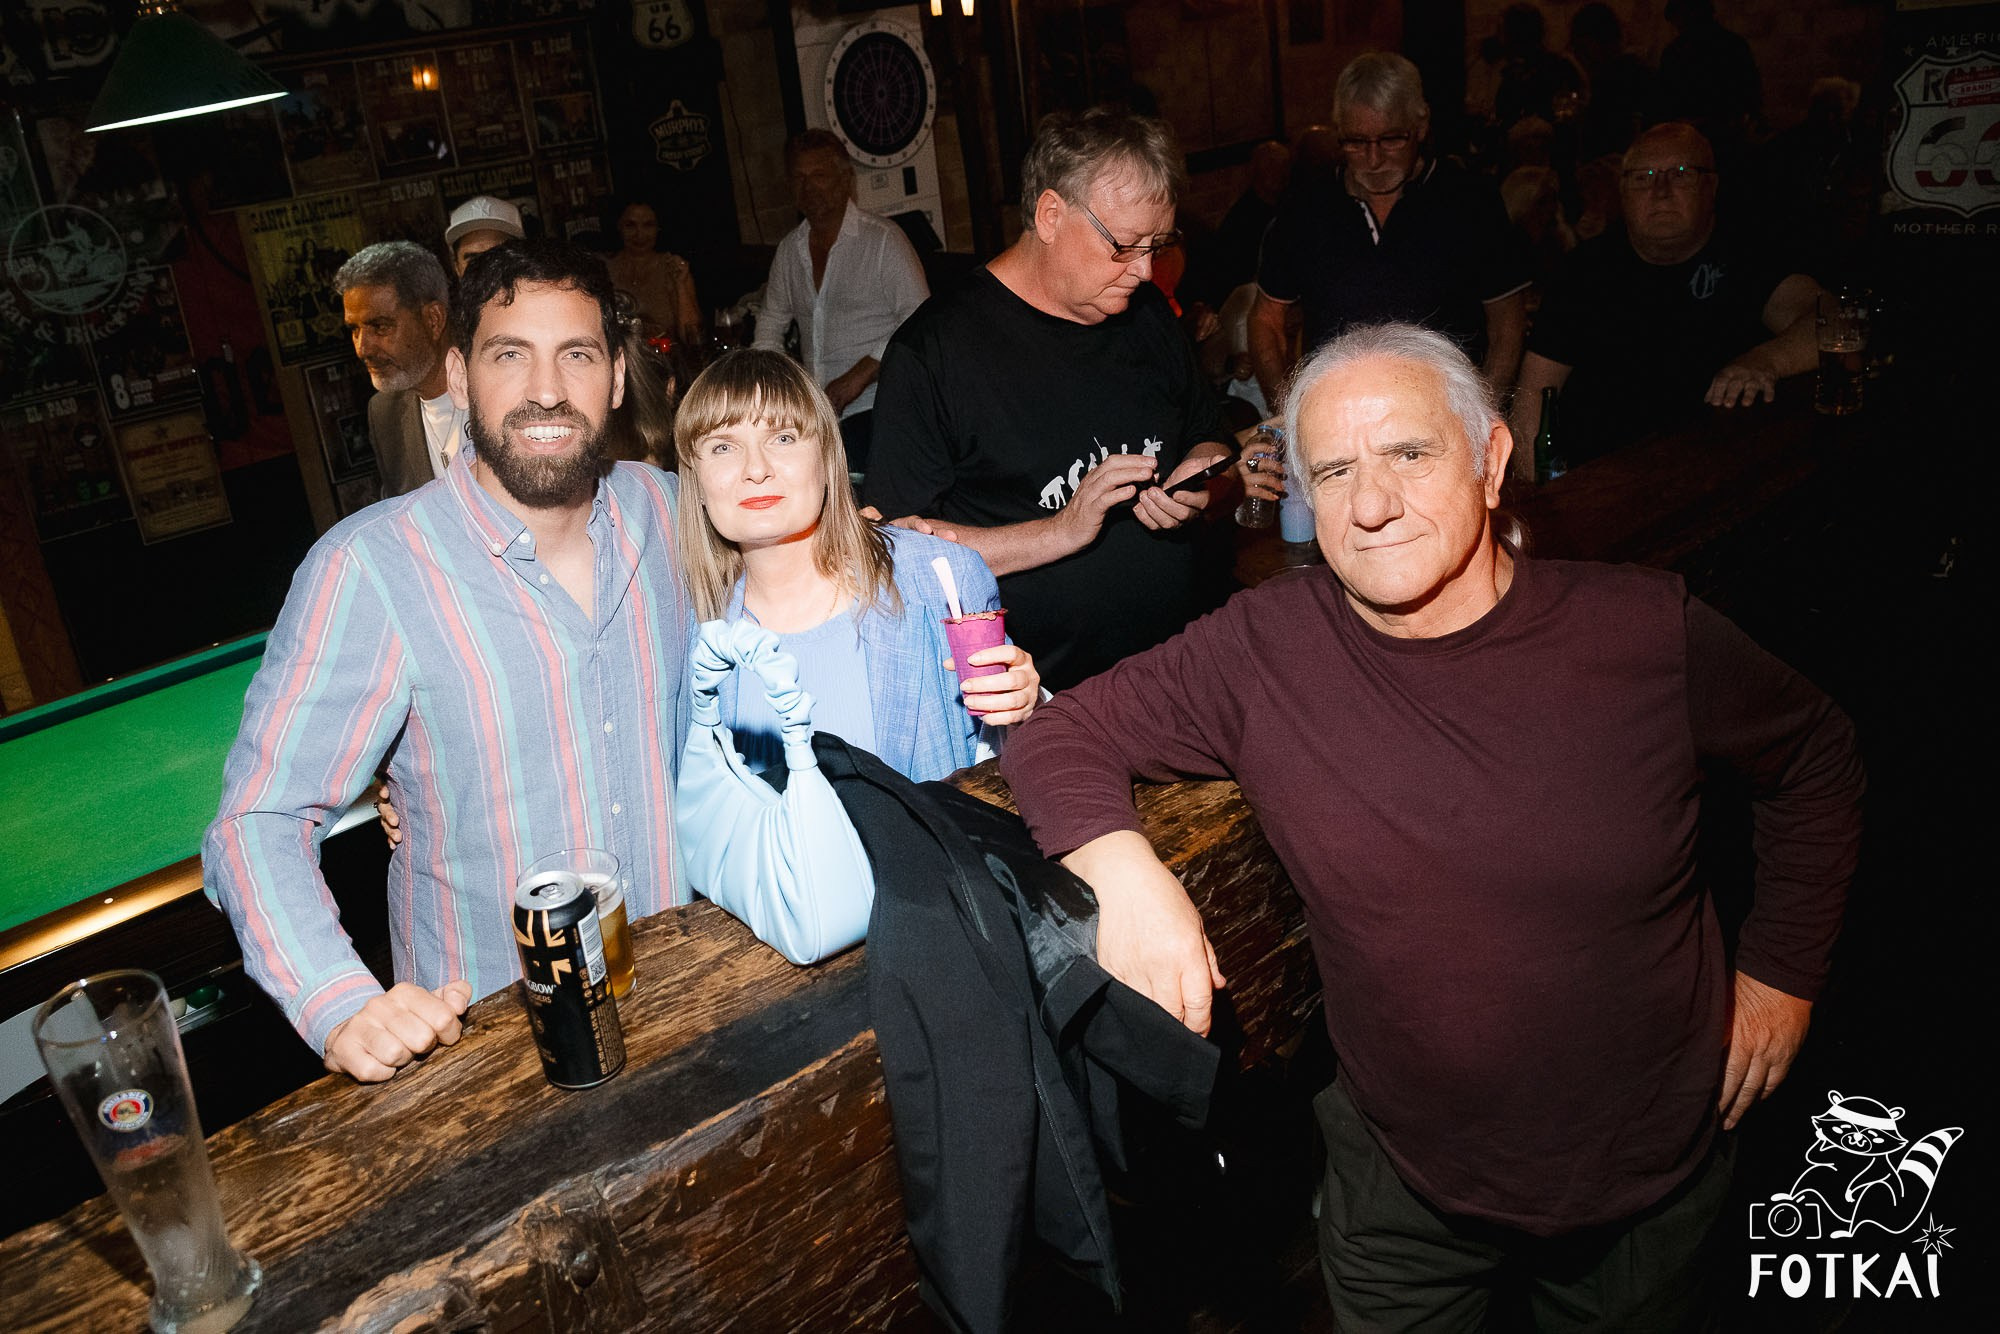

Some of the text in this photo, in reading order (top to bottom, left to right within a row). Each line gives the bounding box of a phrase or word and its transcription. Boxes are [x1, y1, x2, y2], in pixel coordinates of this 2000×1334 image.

[648, 15, 681, 43] 66
[1926, 32, 2000, 50] AMERI
[390, 178, 435, 202] EL PASO
[1893, 224, 2000, 235] MOTHER R
